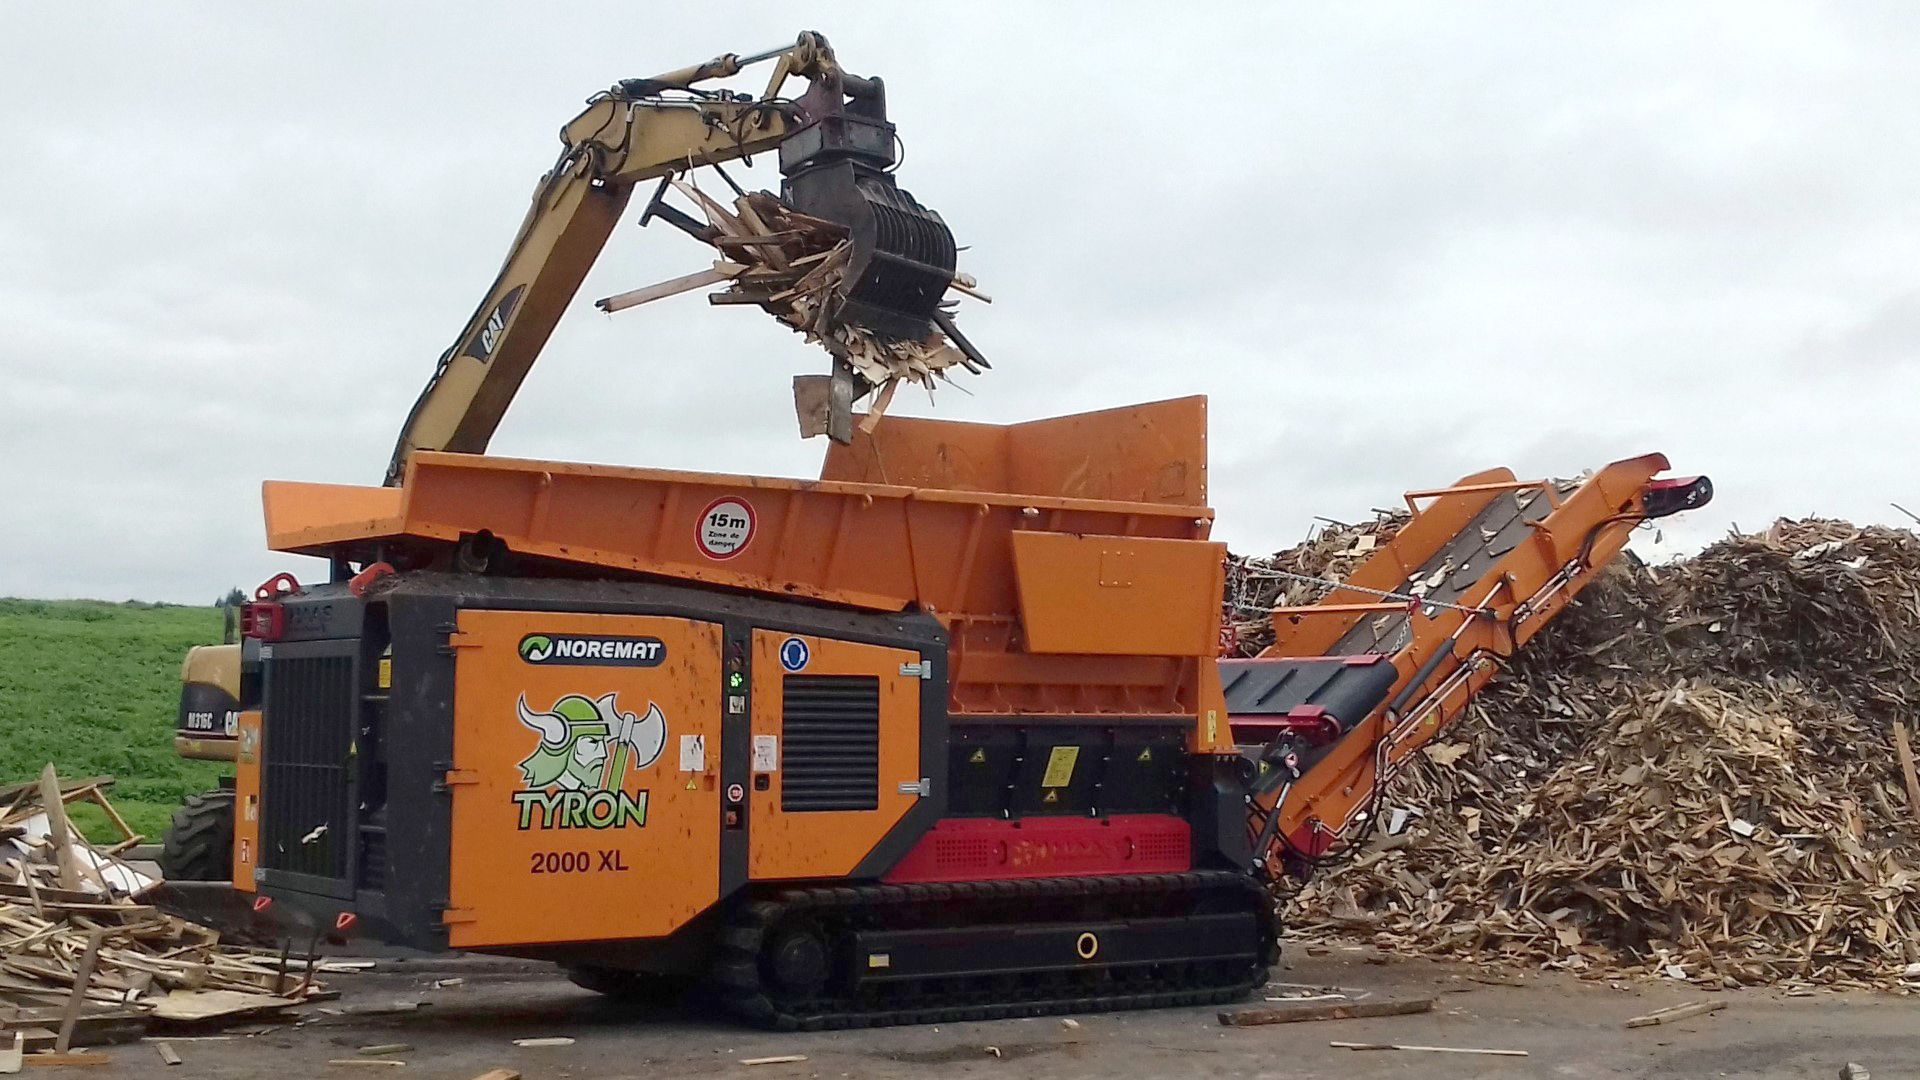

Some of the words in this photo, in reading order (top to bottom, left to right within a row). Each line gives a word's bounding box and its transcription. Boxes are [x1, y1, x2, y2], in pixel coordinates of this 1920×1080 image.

[482, 306, 504, 354] CAT
[708, 540, 735, 548] danger
[556, 640, 661, 660] NOREMAT
[512, 789, 650, 830] TYRON
[531, 851, 591, 874] 2000
[598, 849, 630, 872] XL
